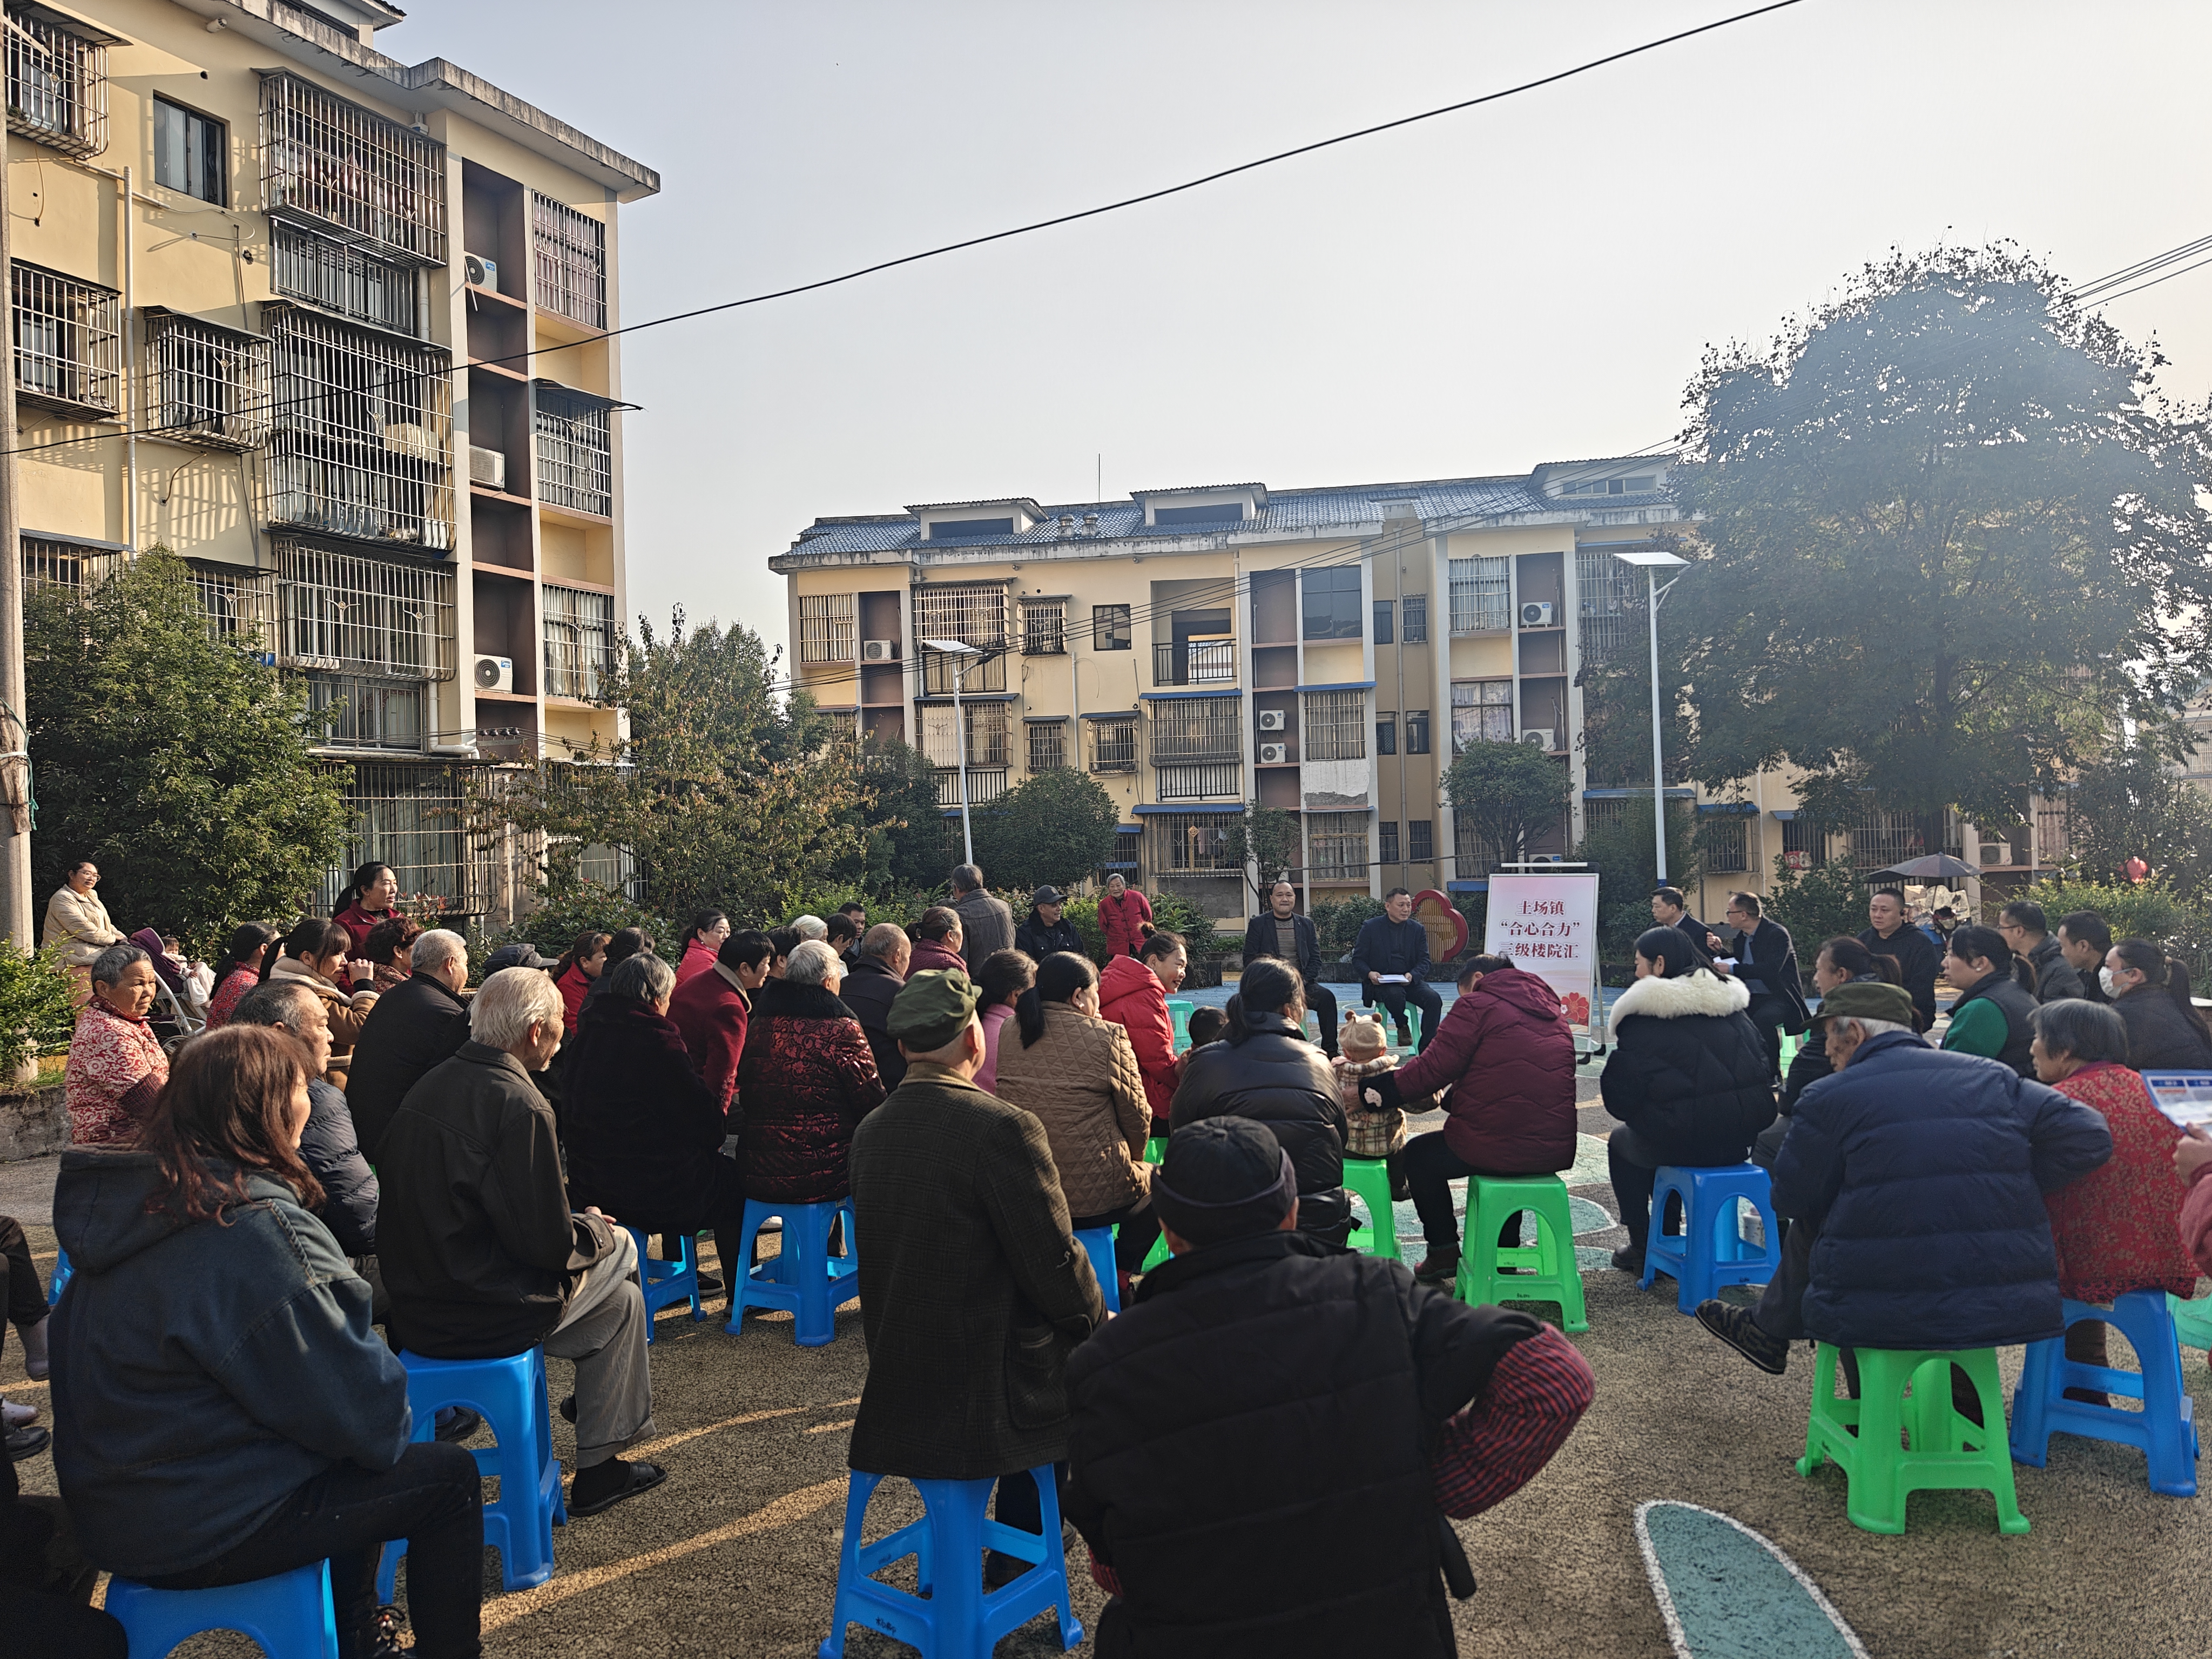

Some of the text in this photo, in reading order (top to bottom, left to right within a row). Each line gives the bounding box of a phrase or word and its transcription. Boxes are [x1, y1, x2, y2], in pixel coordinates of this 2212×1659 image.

[1517, 901, 1564, 915] 土场镇
[1501, 921, 1580, 936] “合心合力”
[1500, 942, 1579, 958] 三级楼院汇
